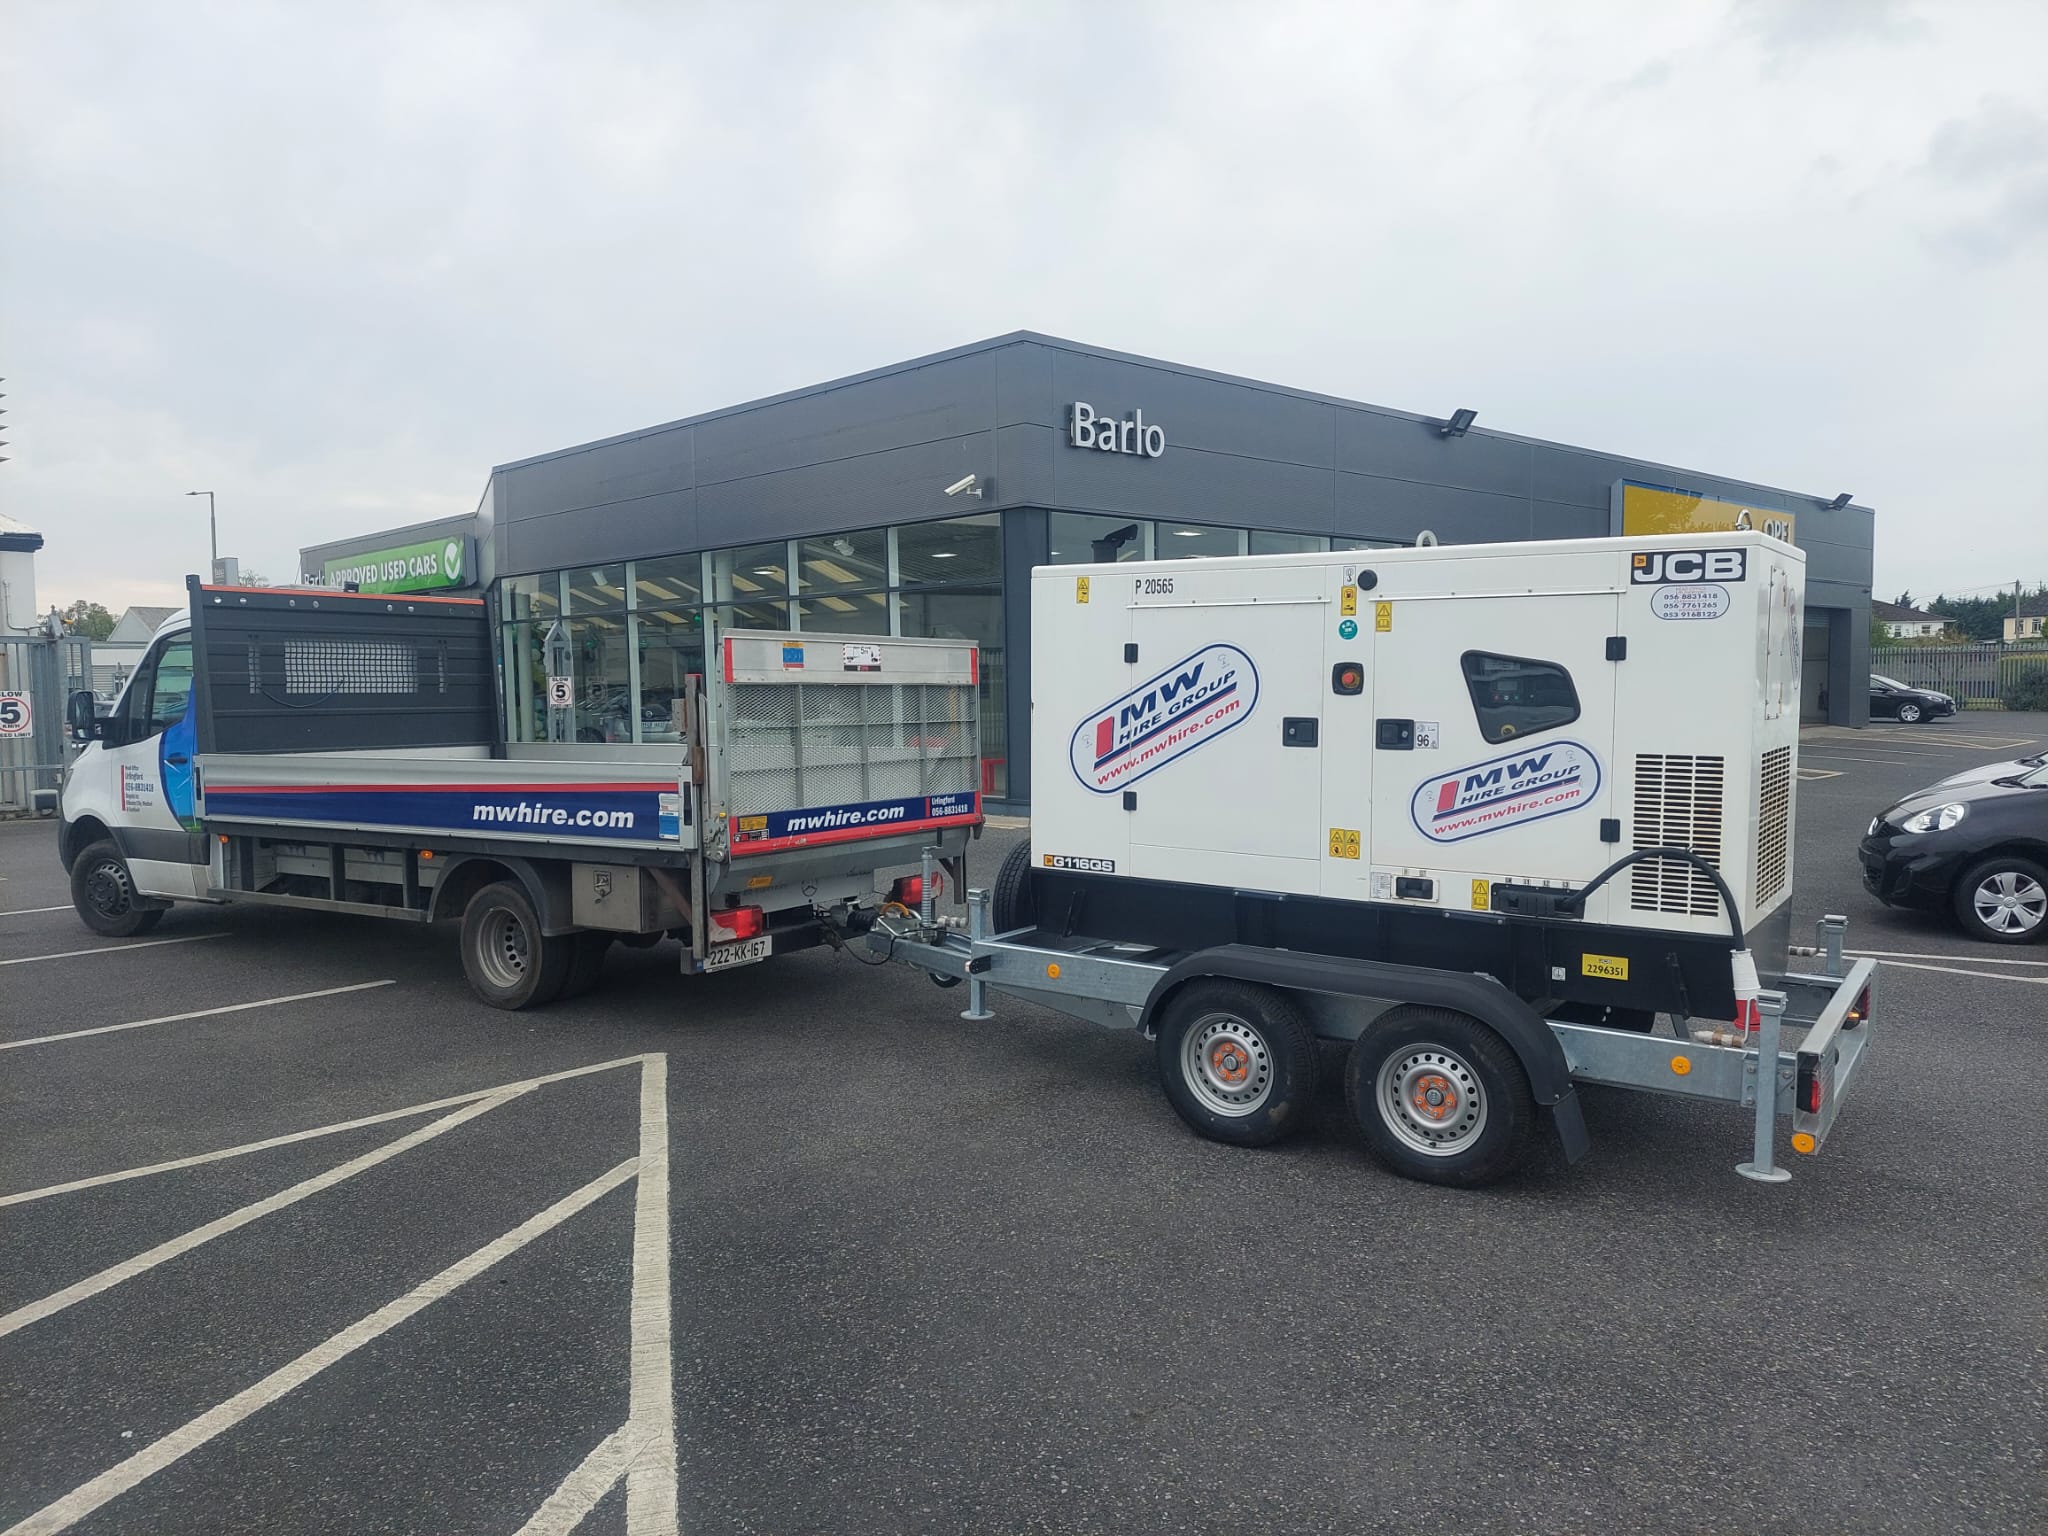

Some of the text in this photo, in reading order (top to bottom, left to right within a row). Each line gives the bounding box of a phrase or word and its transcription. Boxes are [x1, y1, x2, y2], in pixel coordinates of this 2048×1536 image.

[1070, 401, 1165, 458] Barlo
[329, 553, 438, 586] APPROVED USED CARS
[1633, 551, 1743, 582] JCB
[1135, 577, 1174, 595] P 20565
[555, 684, 566, 699] 5
[1120, 661, 1205, 729] MW
[0, 701, 21, 725] 5
[1118, 669, 1236, 745] HIRE GROUP
[1097, 699, 1241, 785] www.mwhire.com
[1416, 734, 1430, 747] 96
[1460, 764, 1581, 805] HIRE GROUP
[1464, 752, 1553, 793] MW
[931, 795, 956, 806] Urlingford
[1434, 789, 1581, 835] www.mwhire.com
[472, 801, 635, 829] mwhire.com
[786, 805, 905, 832] mwhire.com
[1053, 856, 1113, 872] G116QS
[710, 940, 766, 966] 222-KK-167
[1587, 964, 1624, 977] 2296351
